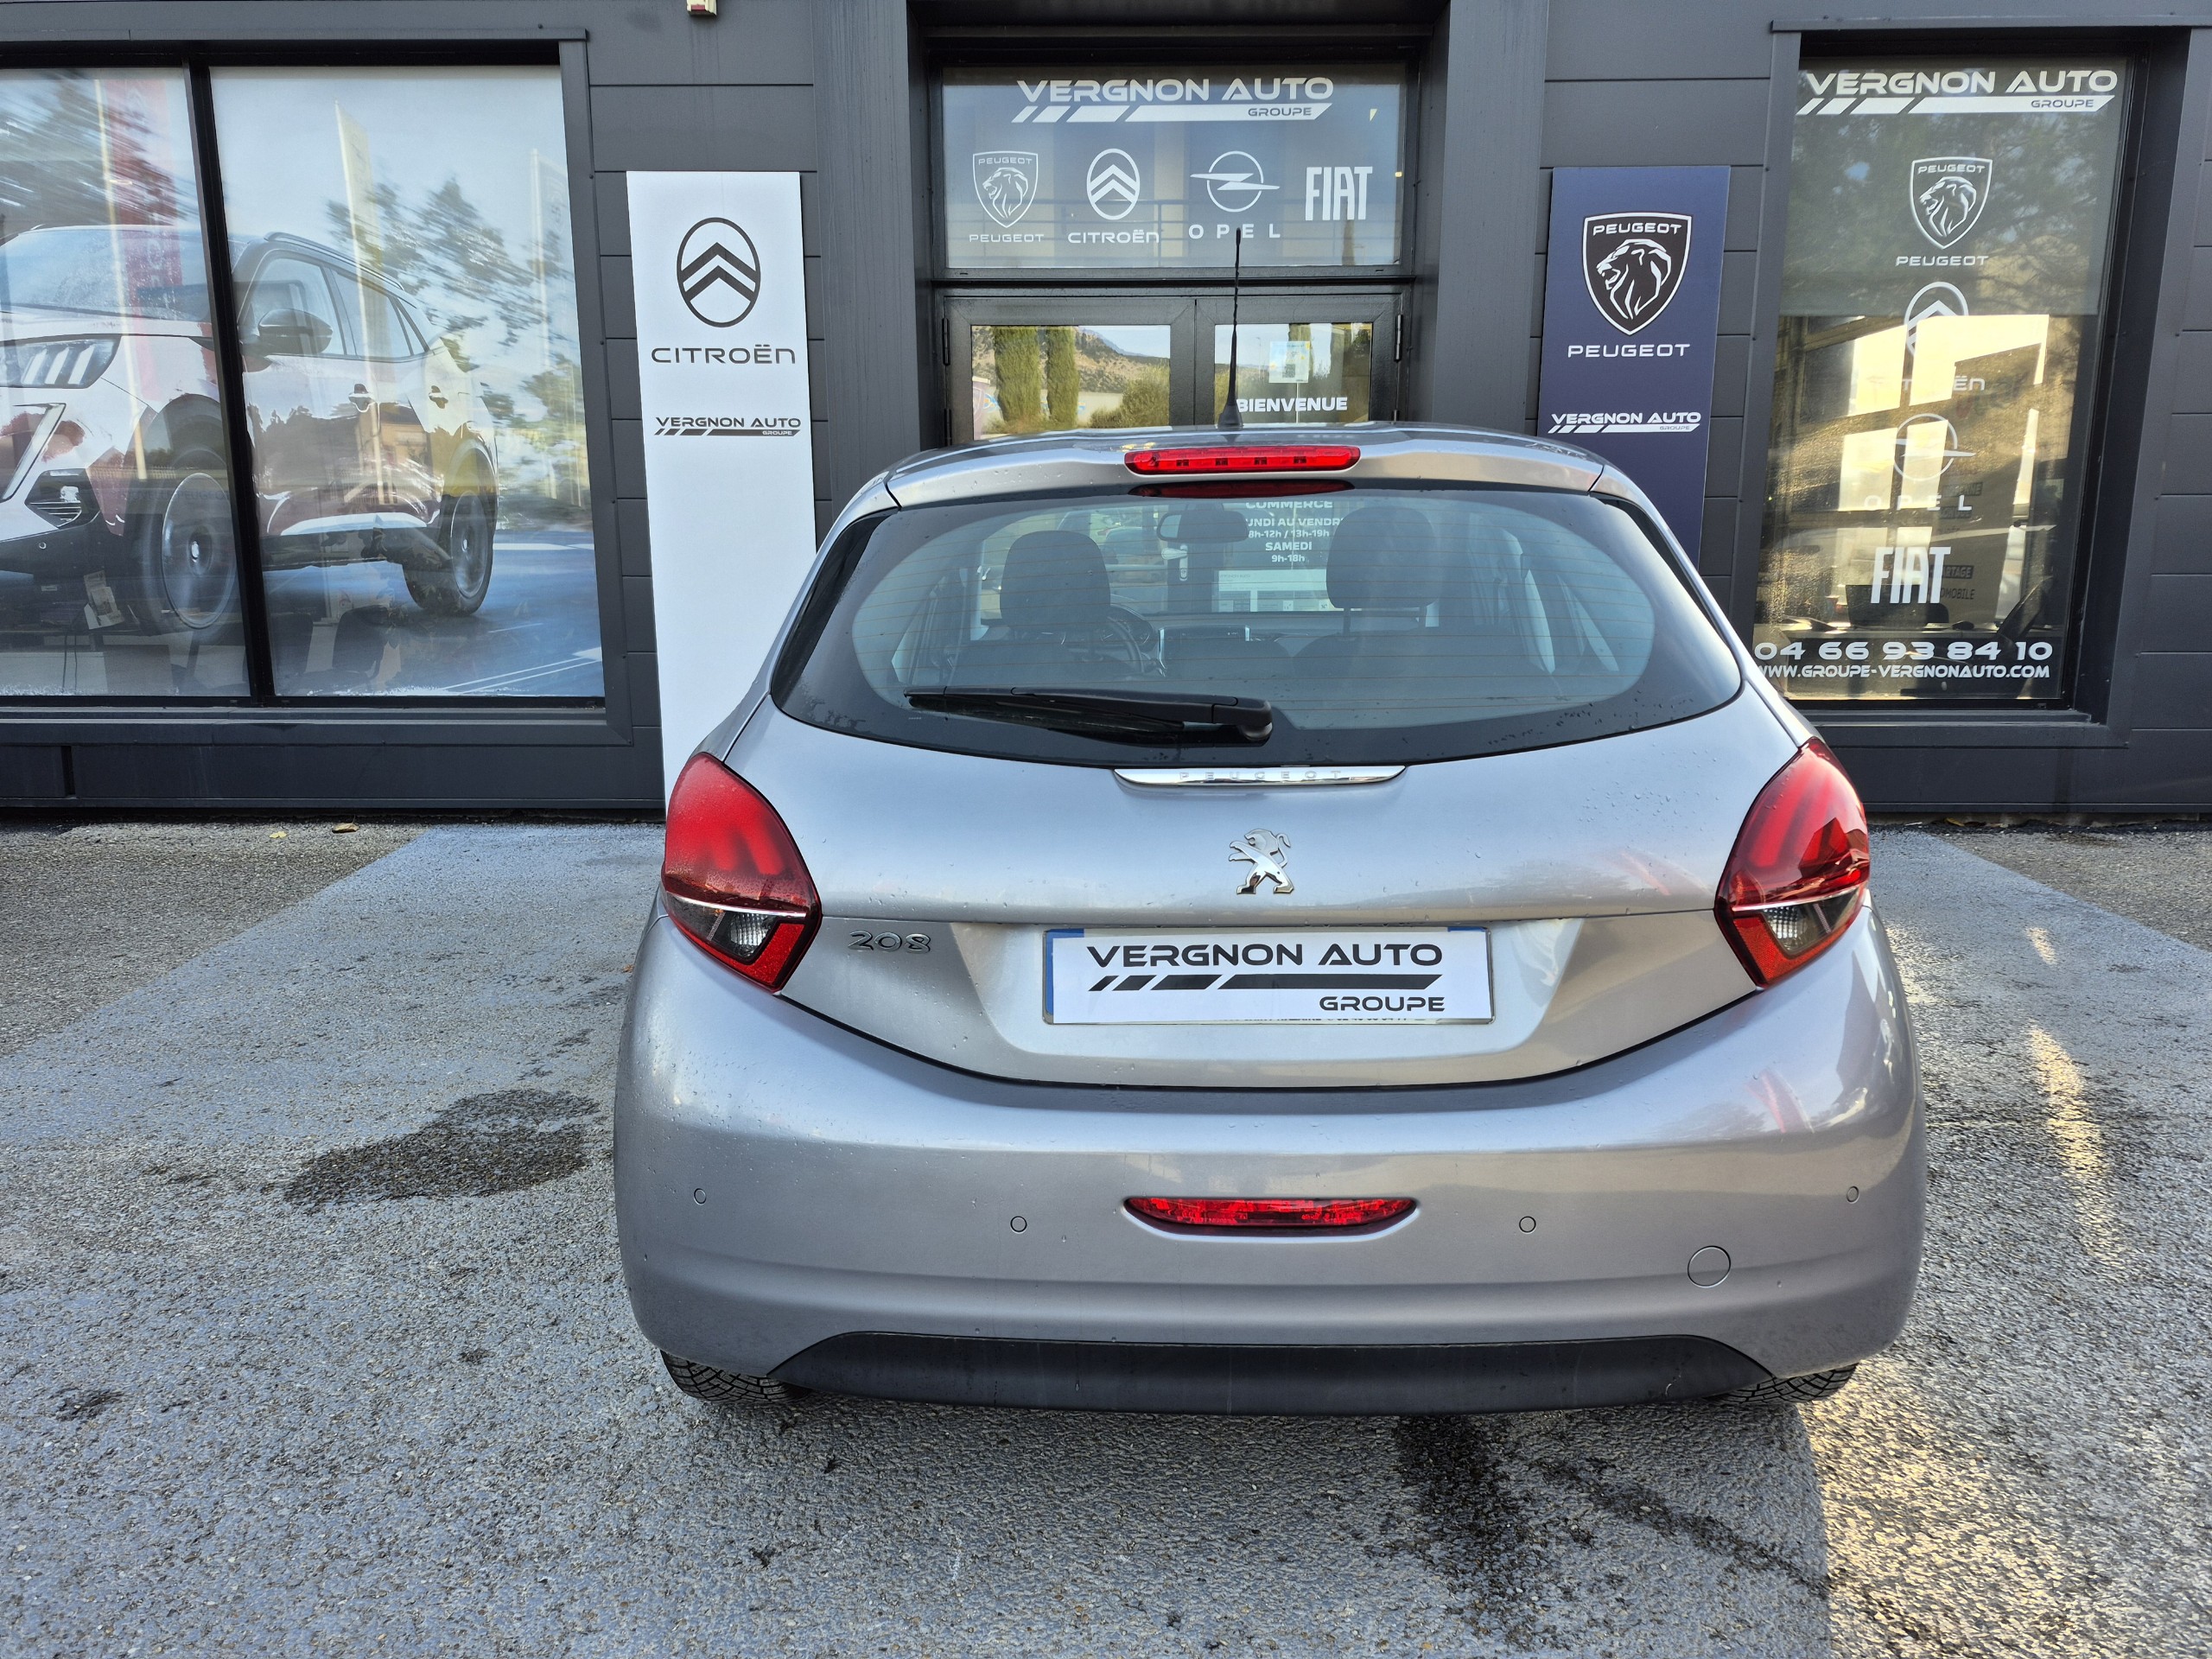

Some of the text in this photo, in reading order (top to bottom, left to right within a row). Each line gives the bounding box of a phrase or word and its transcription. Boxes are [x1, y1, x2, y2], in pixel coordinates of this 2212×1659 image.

[1805, 70, 2118, 95] VERGNON AUTO
[1017, 77, 1334, 103] VERGNON AUTO
[2031, 99, 2094, 109] GROUPE
[1248, 106, 1313, 118] GROUPE
[978, 156, 1033, 166] PEUGEOT
[1917, 163, 1986, 175] PEUGEOT
[1305, 166, 1374, 221] FIAT
[1188, 224, 1281, 239] OPEL
[1592, 222, 1682, 236] PEUGEOT
[969, 233, 1045, 243] PEUGEOT
[1895, 255, 1989, 267] PEUGEOT
[1567, 343, 1691, 359] PEUGEOT
[1236, 396, 1348, 413] BIENVENUE
[655, 416, 801, 429] VERGNON AUTO
[1551, 411, 1701, 425] VERGNON AUTO
[1865, 494, 1973, 512] OPEL
[1246, 518, 1344, 527] UNDI AU VENDR
[1248, 530, 1281, 538] 8h-12h
[1265, 541, 1313, 551] SAMEDI
[1271, 554, 1306, 563] 9h-18h
[1871, 546, 1952, 604] FIAT
[1753, 641, 2053, 661] 04 66 93 84 10
[1179, 770, 1341, 780] PEUGEOT
[848, 930, 931, 954] 208
[1086, 942, 1443, 968] VERGNON AUTO
[1319, 996, 1446, 1012] GROUPE
